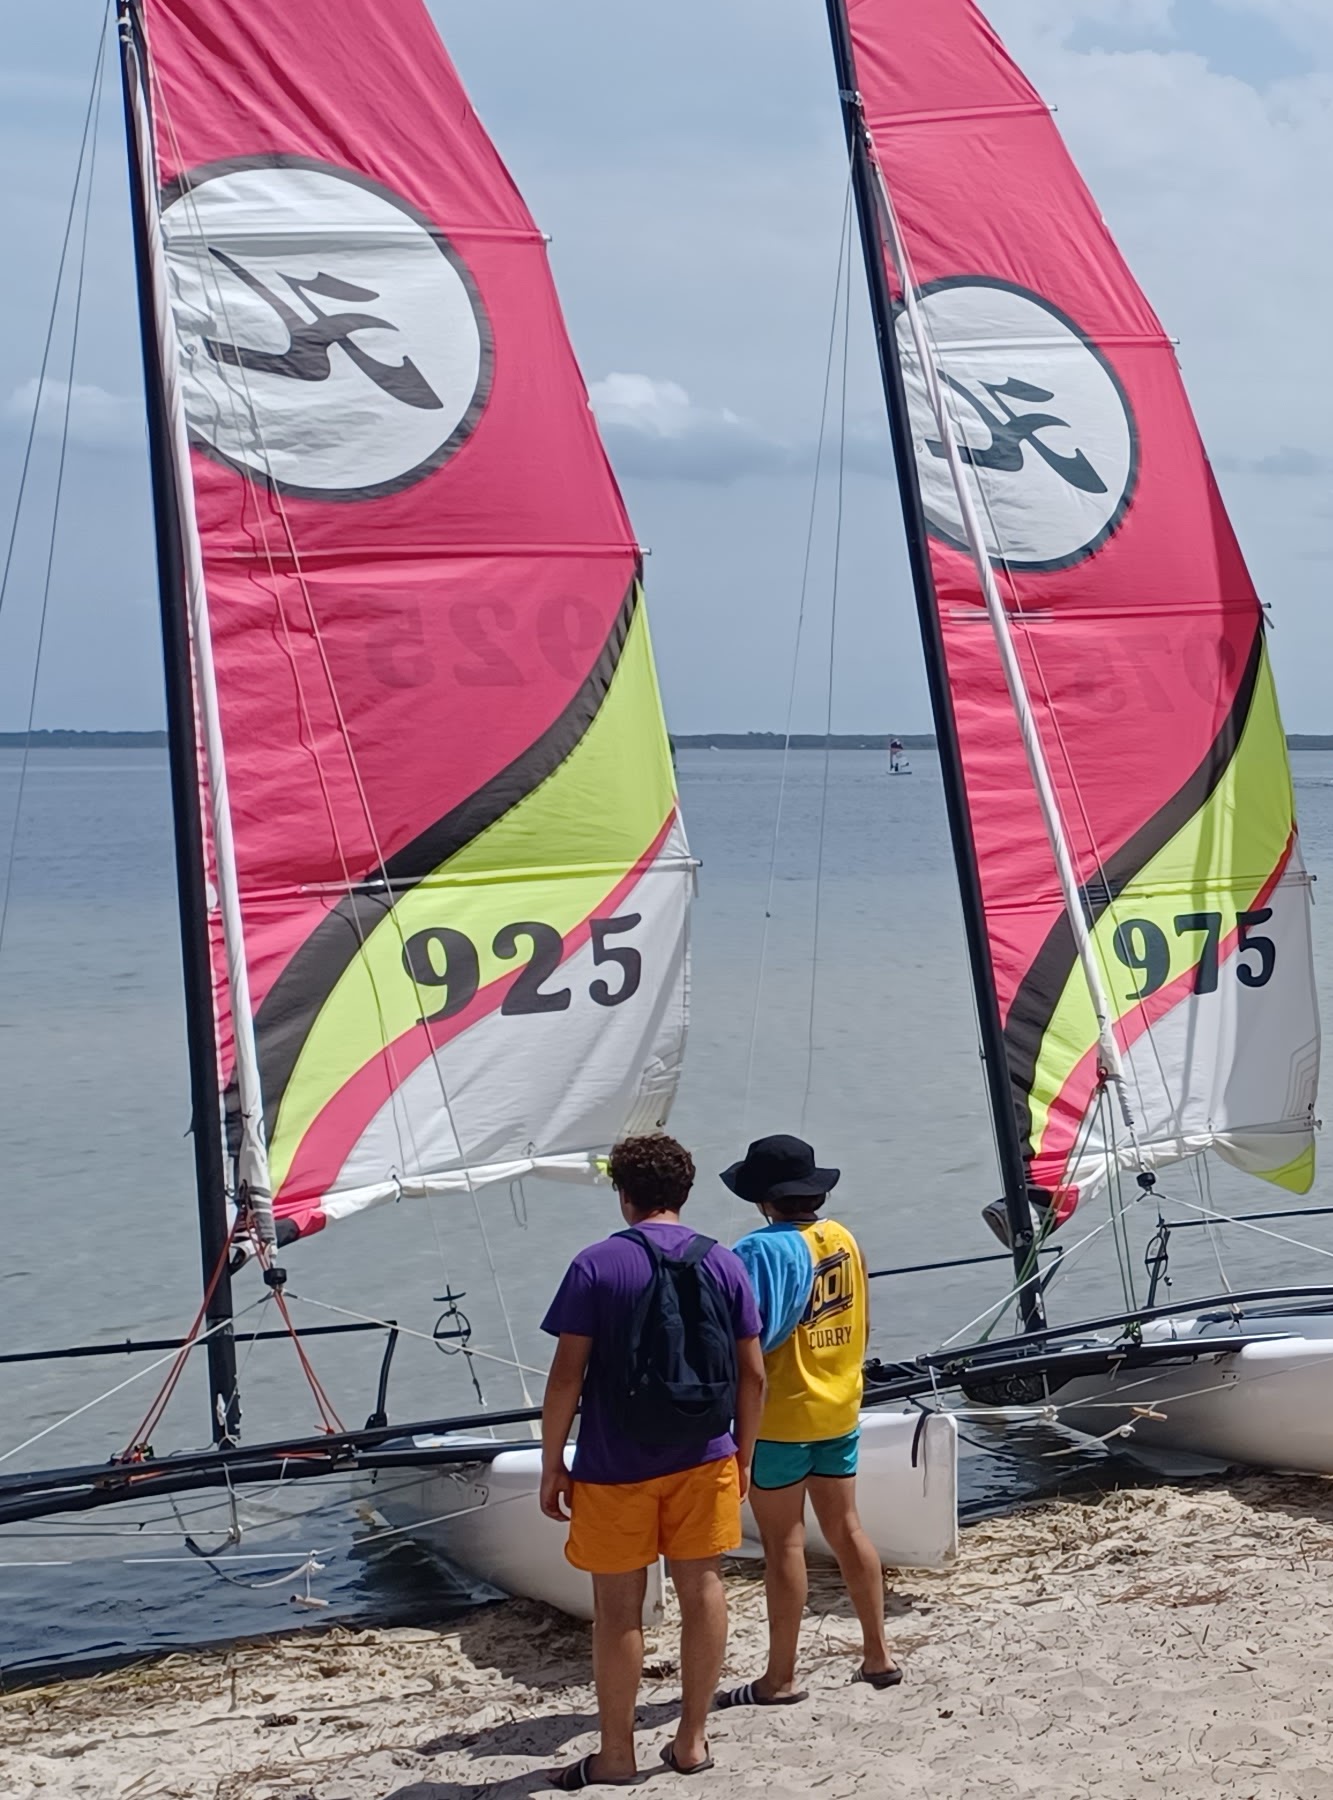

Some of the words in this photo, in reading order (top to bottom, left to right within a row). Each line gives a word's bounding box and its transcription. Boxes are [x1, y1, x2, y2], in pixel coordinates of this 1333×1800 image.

[402, 913, 642, 1025] 925
[1112, 908, 1276, 1001] 975
[808, 1325, 853, 1350] CURRY
